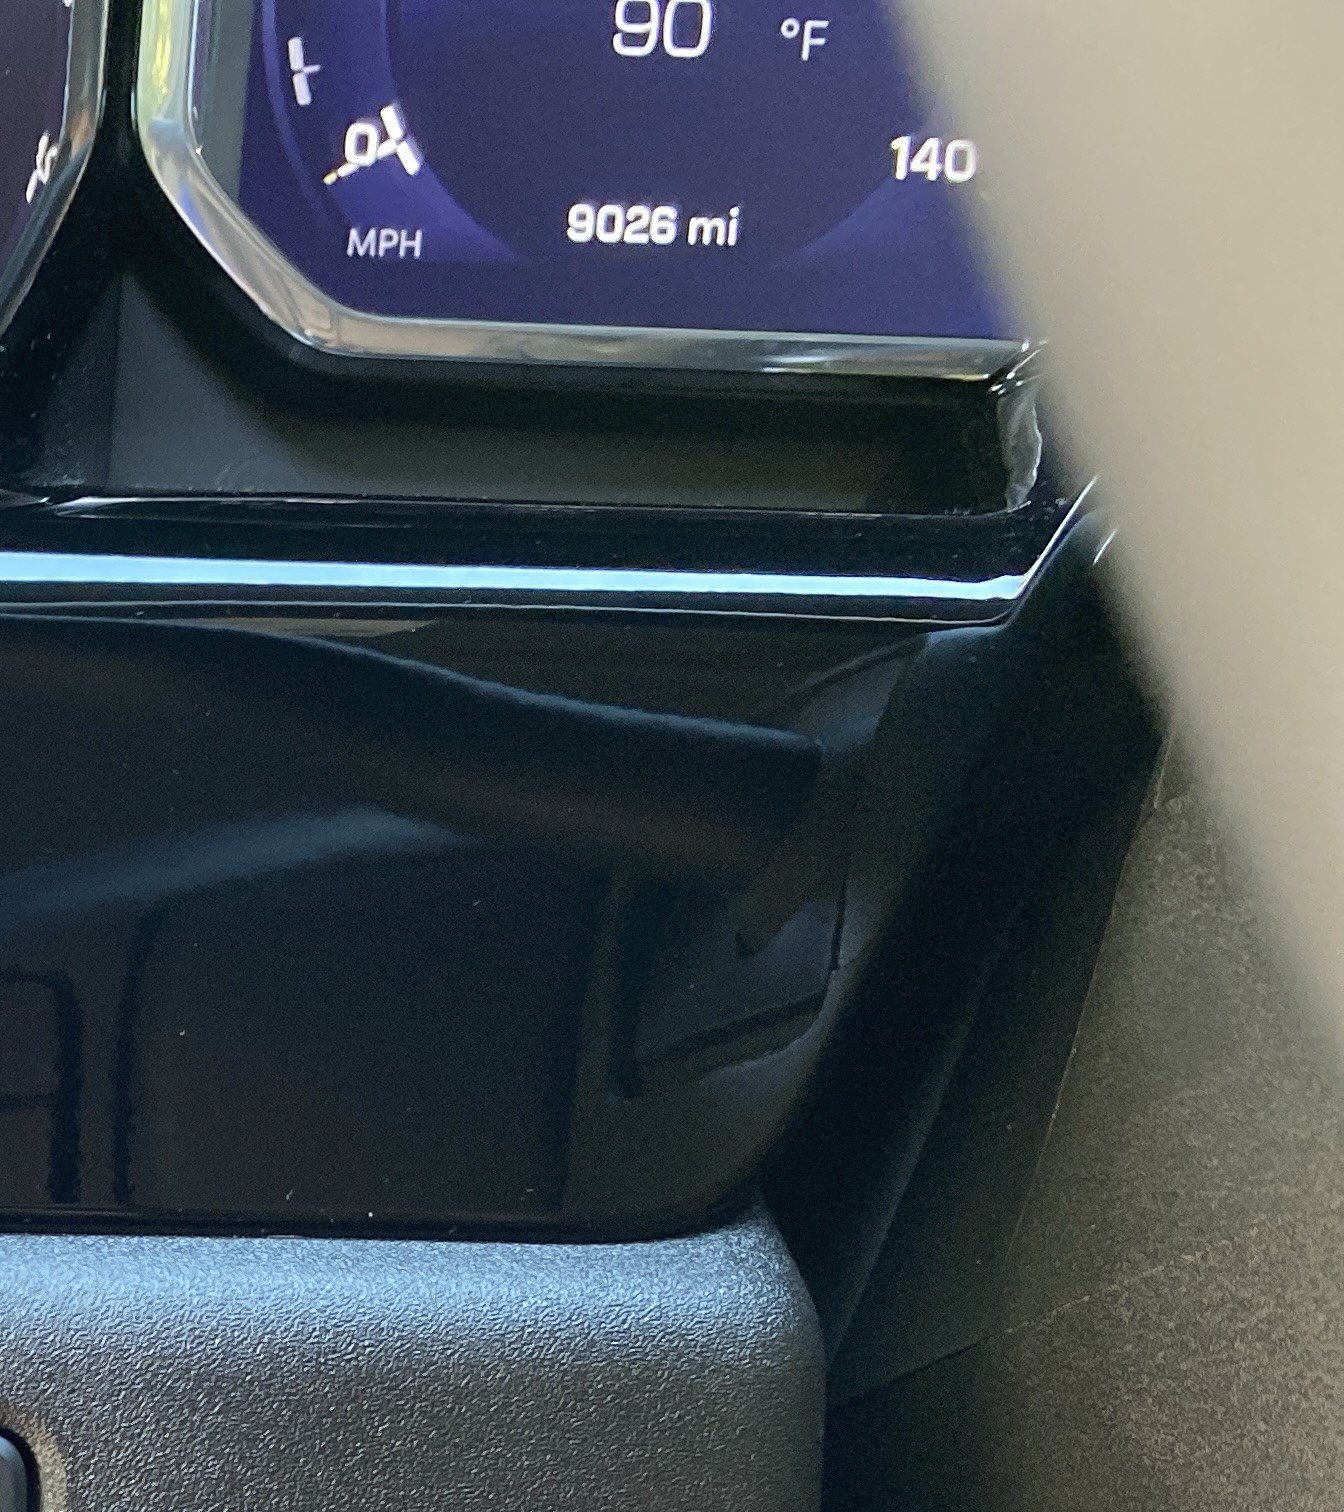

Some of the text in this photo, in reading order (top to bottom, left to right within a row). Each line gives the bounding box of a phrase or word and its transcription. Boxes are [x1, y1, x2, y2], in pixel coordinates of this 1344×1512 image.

[612, 0, 830, 61] 90 °F
[344, 121, 379, 167] 0
[889, 135, 977, 184] 140
[345, 227, 424, 259] MPH
[566, 203, 741, 247] 9026 mi
